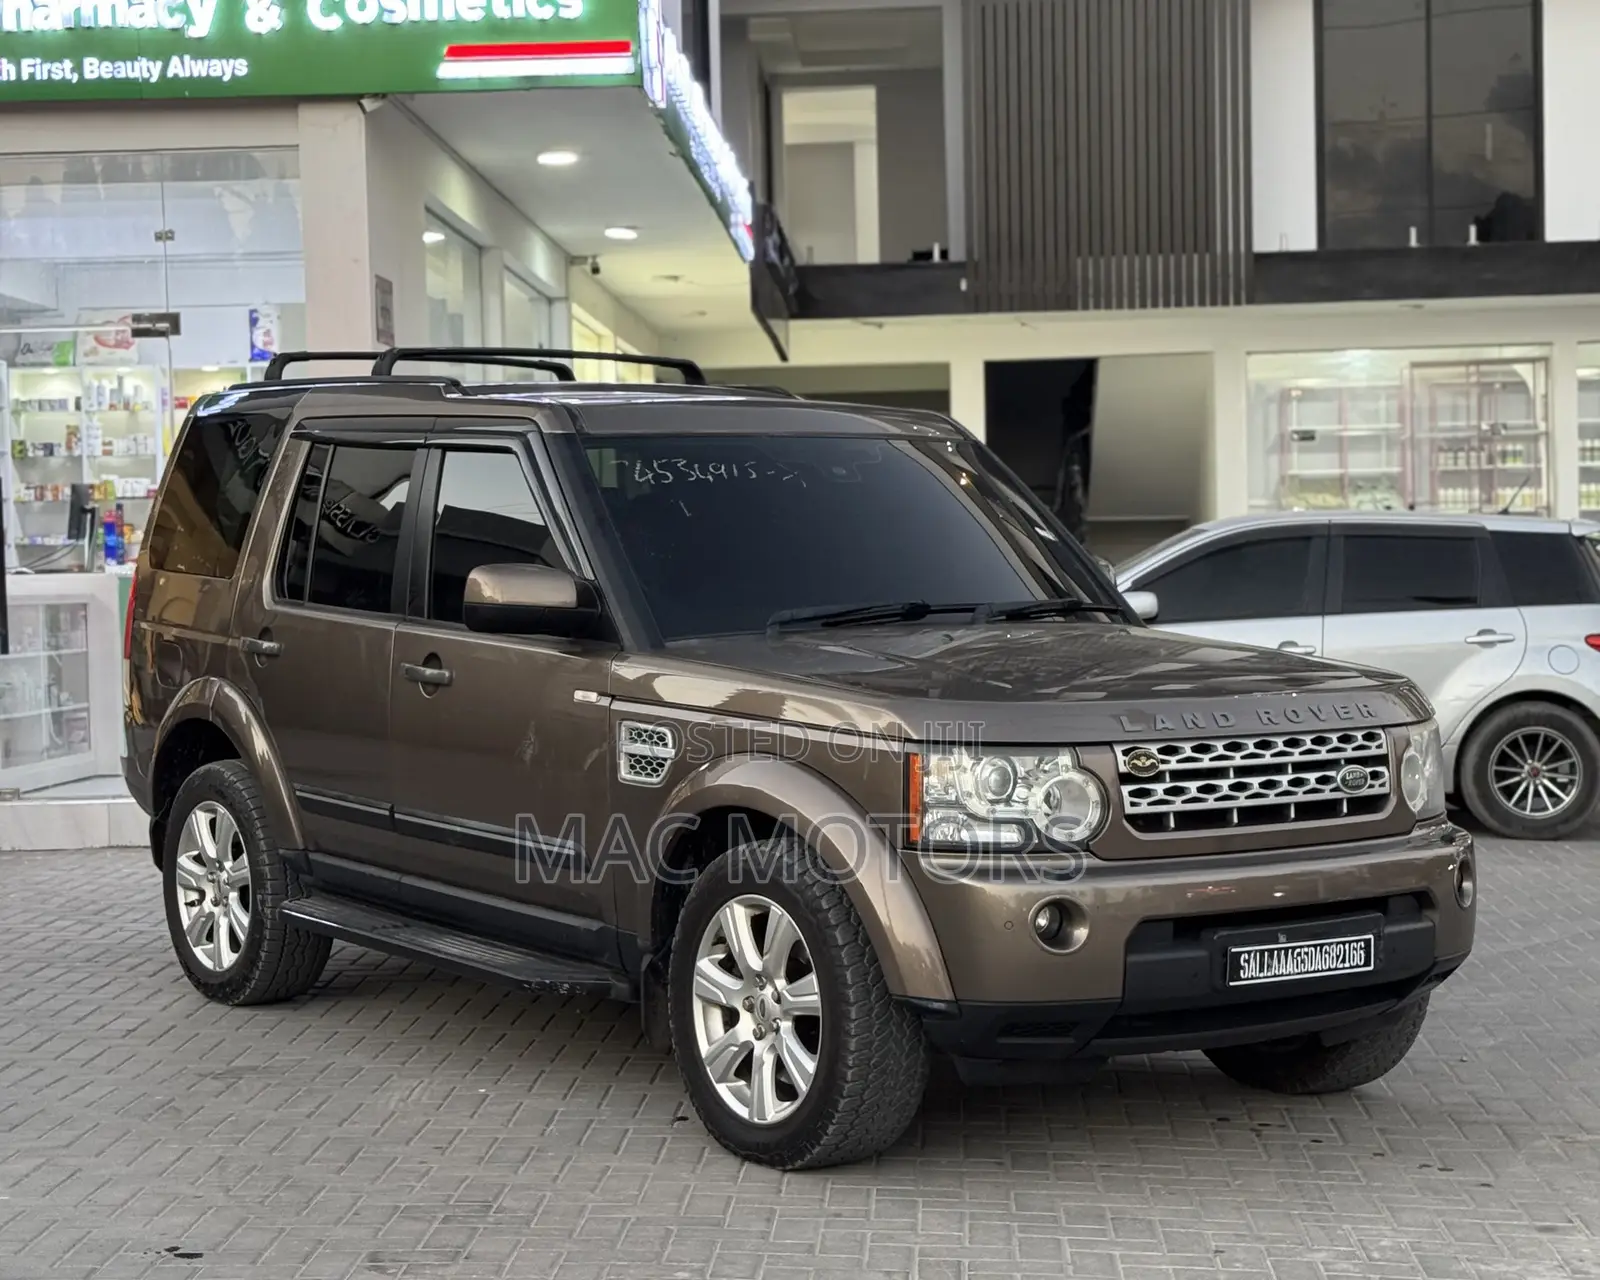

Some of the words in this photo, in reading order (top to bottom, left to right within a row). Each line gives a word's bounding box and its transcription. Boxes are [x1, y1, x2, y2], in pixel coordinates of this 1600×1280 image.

[0, 57, 16, 81] h
[20, 57, 78, 83] First,
[83, 56, 162, 83] Beauty
[166, 54, 249, 82] Always
[1120, 711, 1236, 733] LAND
[1256, 702, 1377, 726] ROVER
